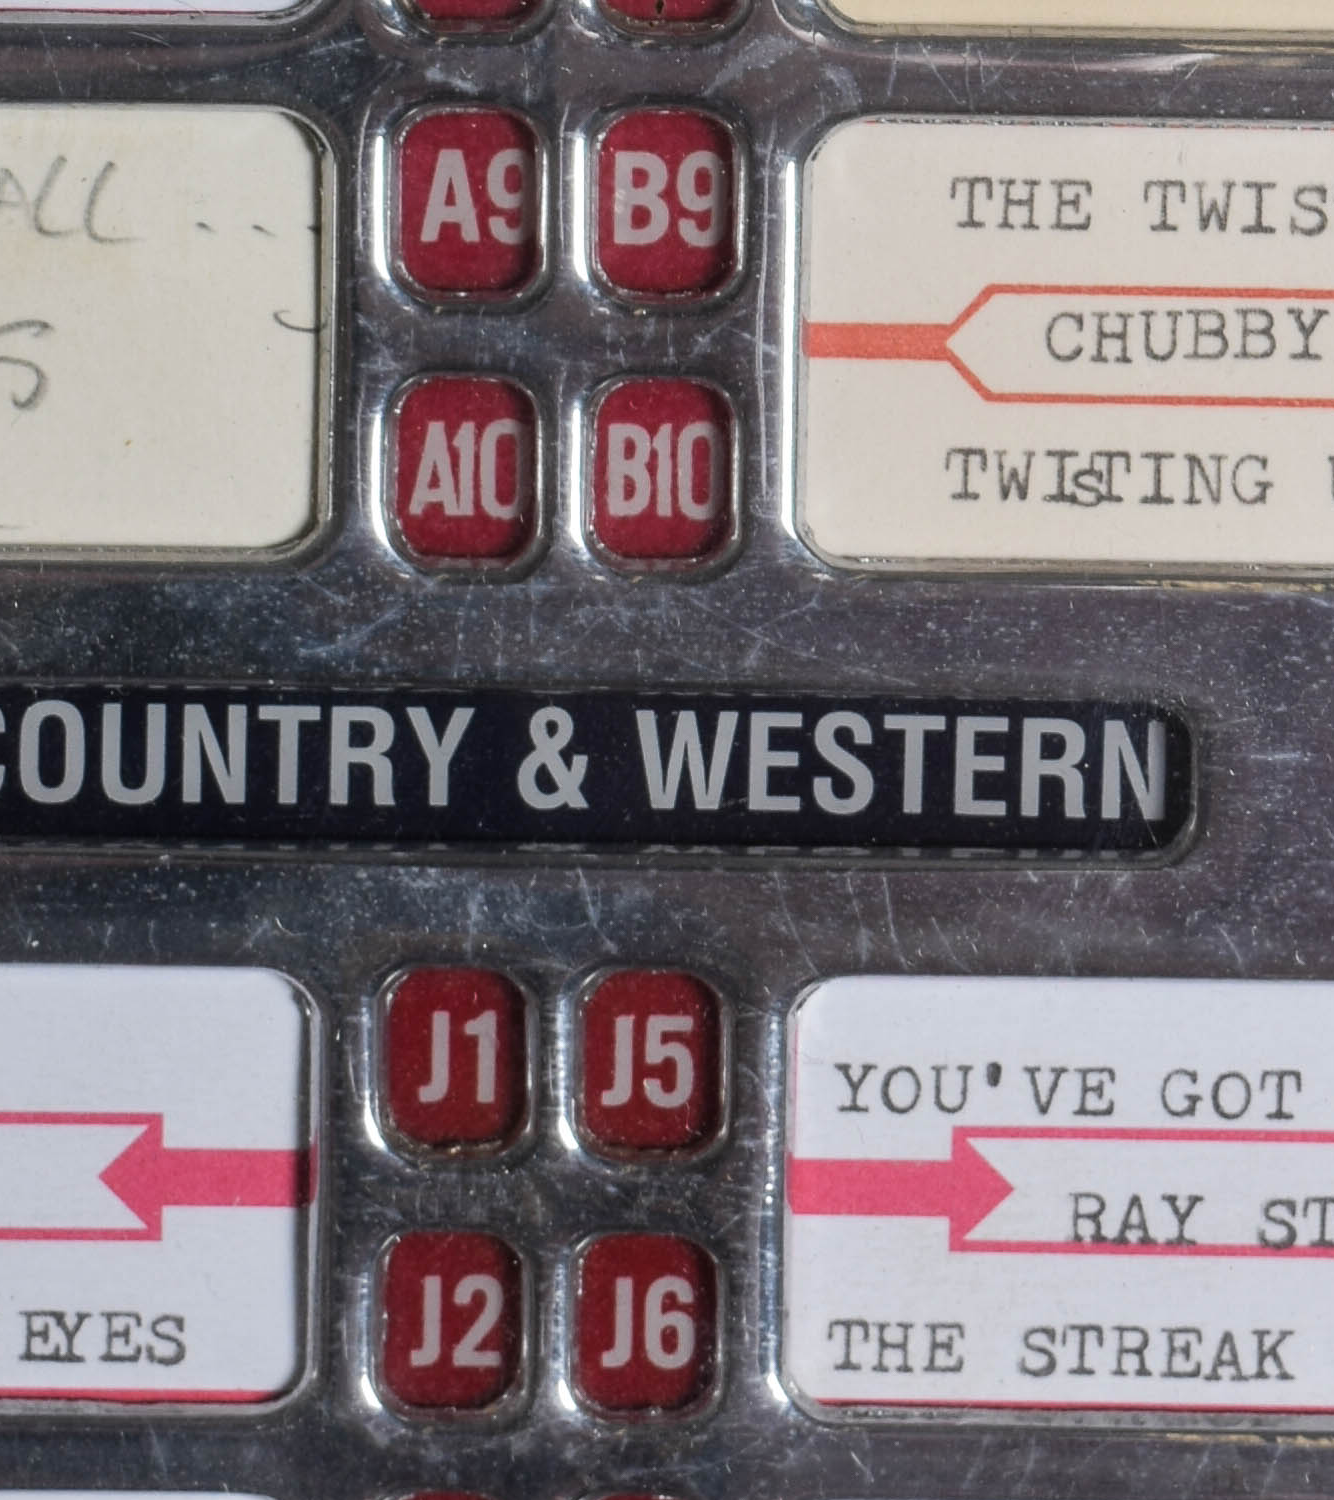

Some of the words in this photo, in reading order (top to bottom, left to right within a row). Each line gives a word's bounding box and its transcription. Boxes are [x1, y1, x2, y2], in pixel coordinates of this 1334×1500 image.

[420, 148, 535, 244] A9
[613, 150, 725, 248] B9
[950, 176, 1093, 231] THE
[1045, 307, 1330, 364] CHUBBY
[409, 419, 523, 520] A10
[606, 421, 718, 521] B10
[517, 706, 588, 809] &
[636, 710, 1163, 820] WESTERN
[418, 1009, 498, 1104] J1
[601, 1014, 695, 1110] J5
[834, 1061, 1116, 1117] YOU'VE
[1160, 1068, 1302, 1121] GOT
[1059, 1192, 1205, 1245] RAY
[18, 1310, 186, 1367] EYES
[410, 1274, 502, 1369] J2
[601, 1275, 695, 1370] J6
[827, 1318, 965, 1373] THE
[1017, 1323, 1295, 1382] STREAK
